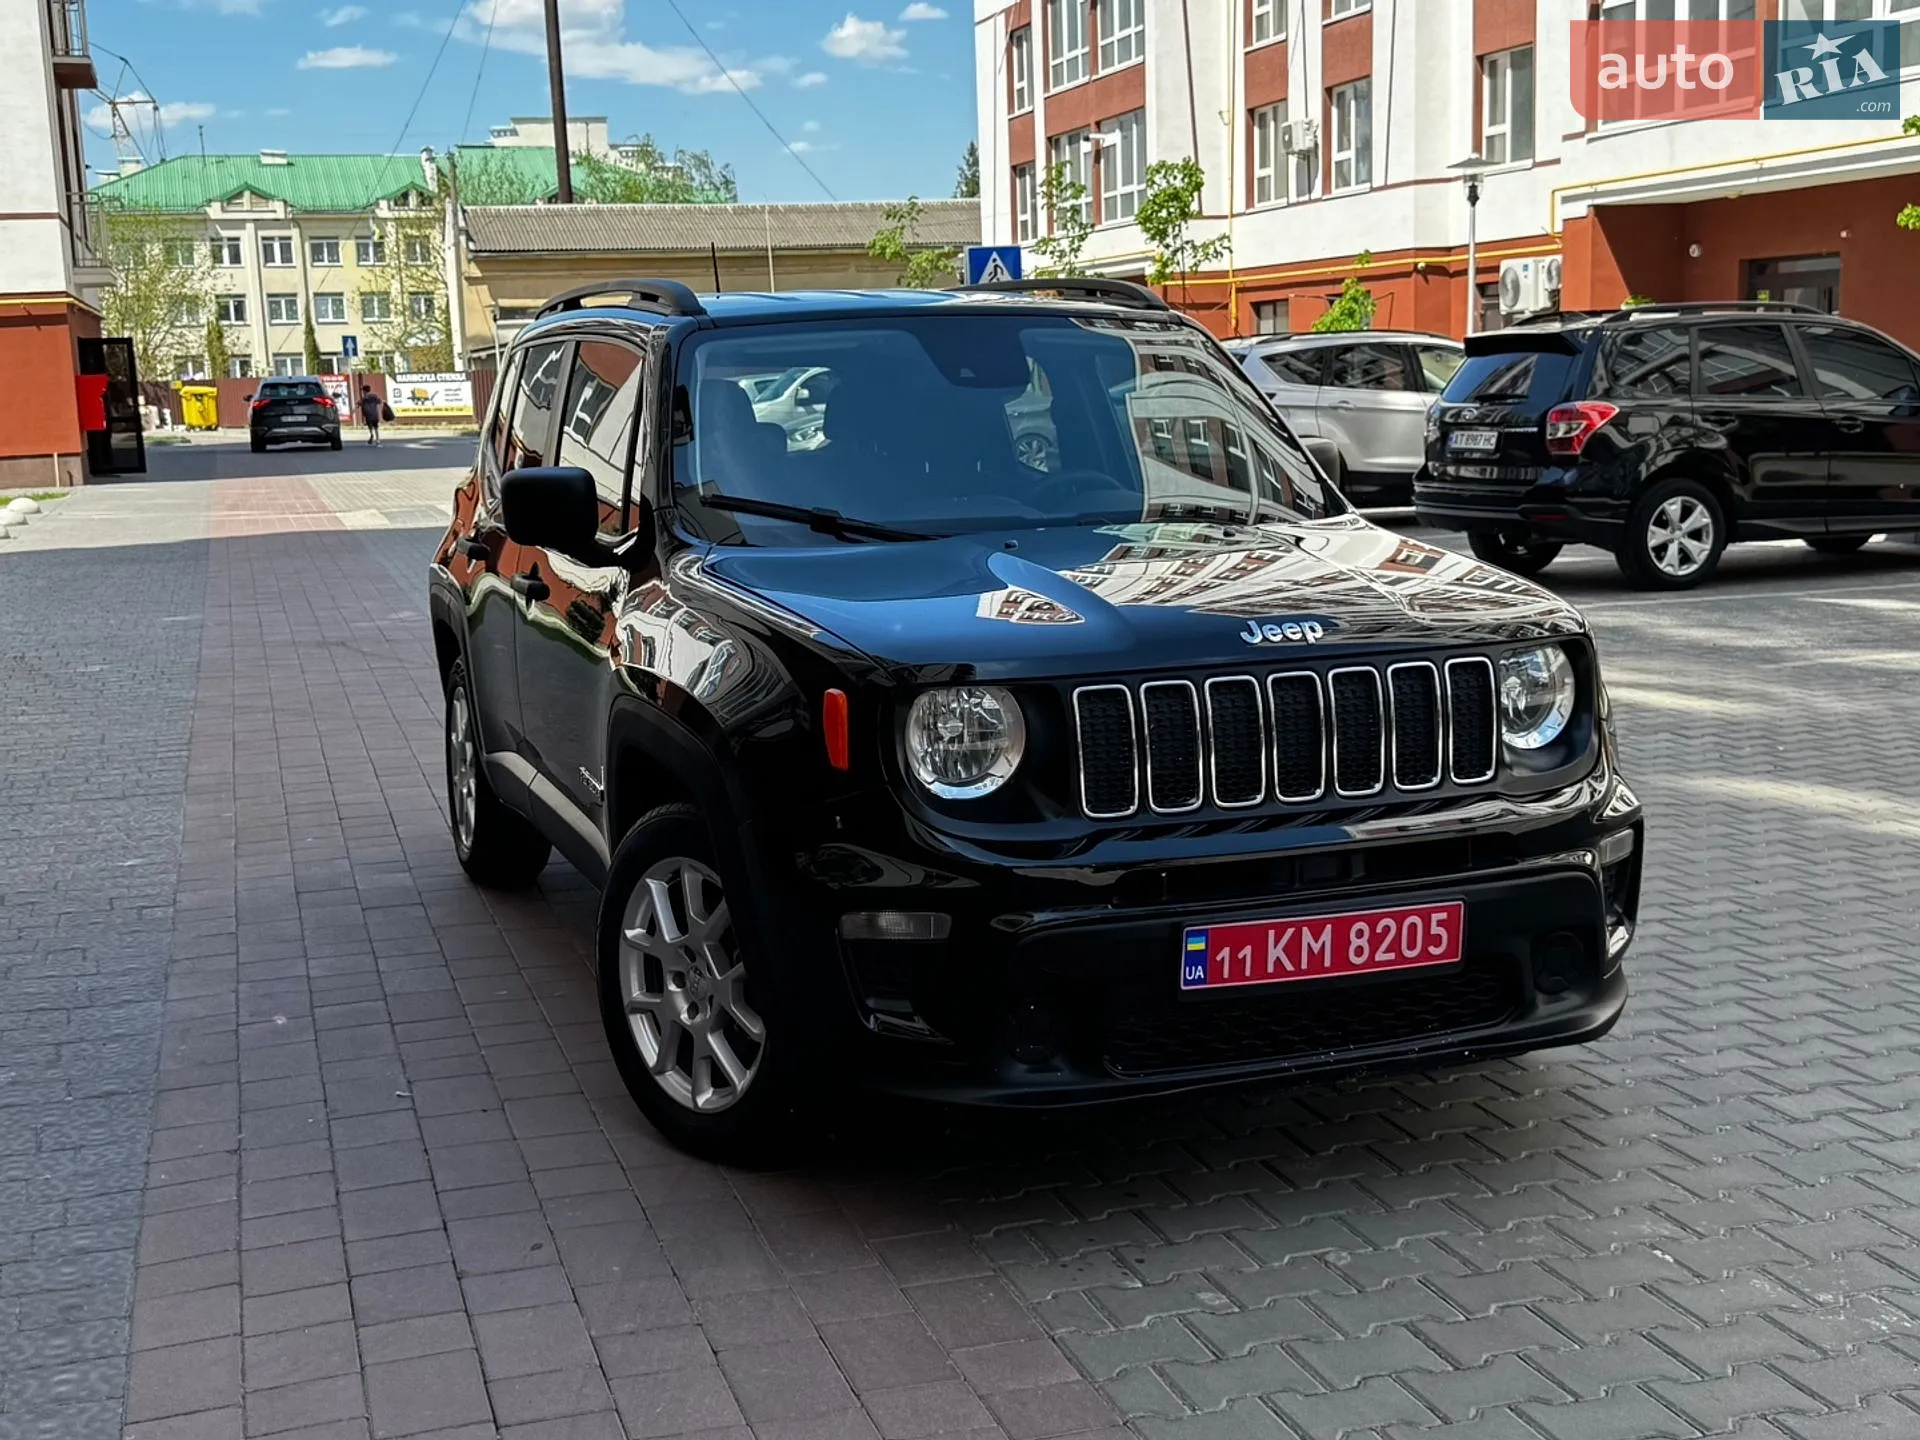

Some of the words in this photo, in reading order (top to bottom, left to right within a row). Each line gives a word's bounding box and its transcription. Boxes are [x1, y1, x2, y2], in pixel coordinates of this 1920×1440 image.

[1240, 620, 1324, 645] Jeep
[1215, 945, 1252, 979] 11
[1266, 924, 1332, 974] KM
[1348, 912, 1449, 965] 8205
[1185, 965, 1205, 980] UA
